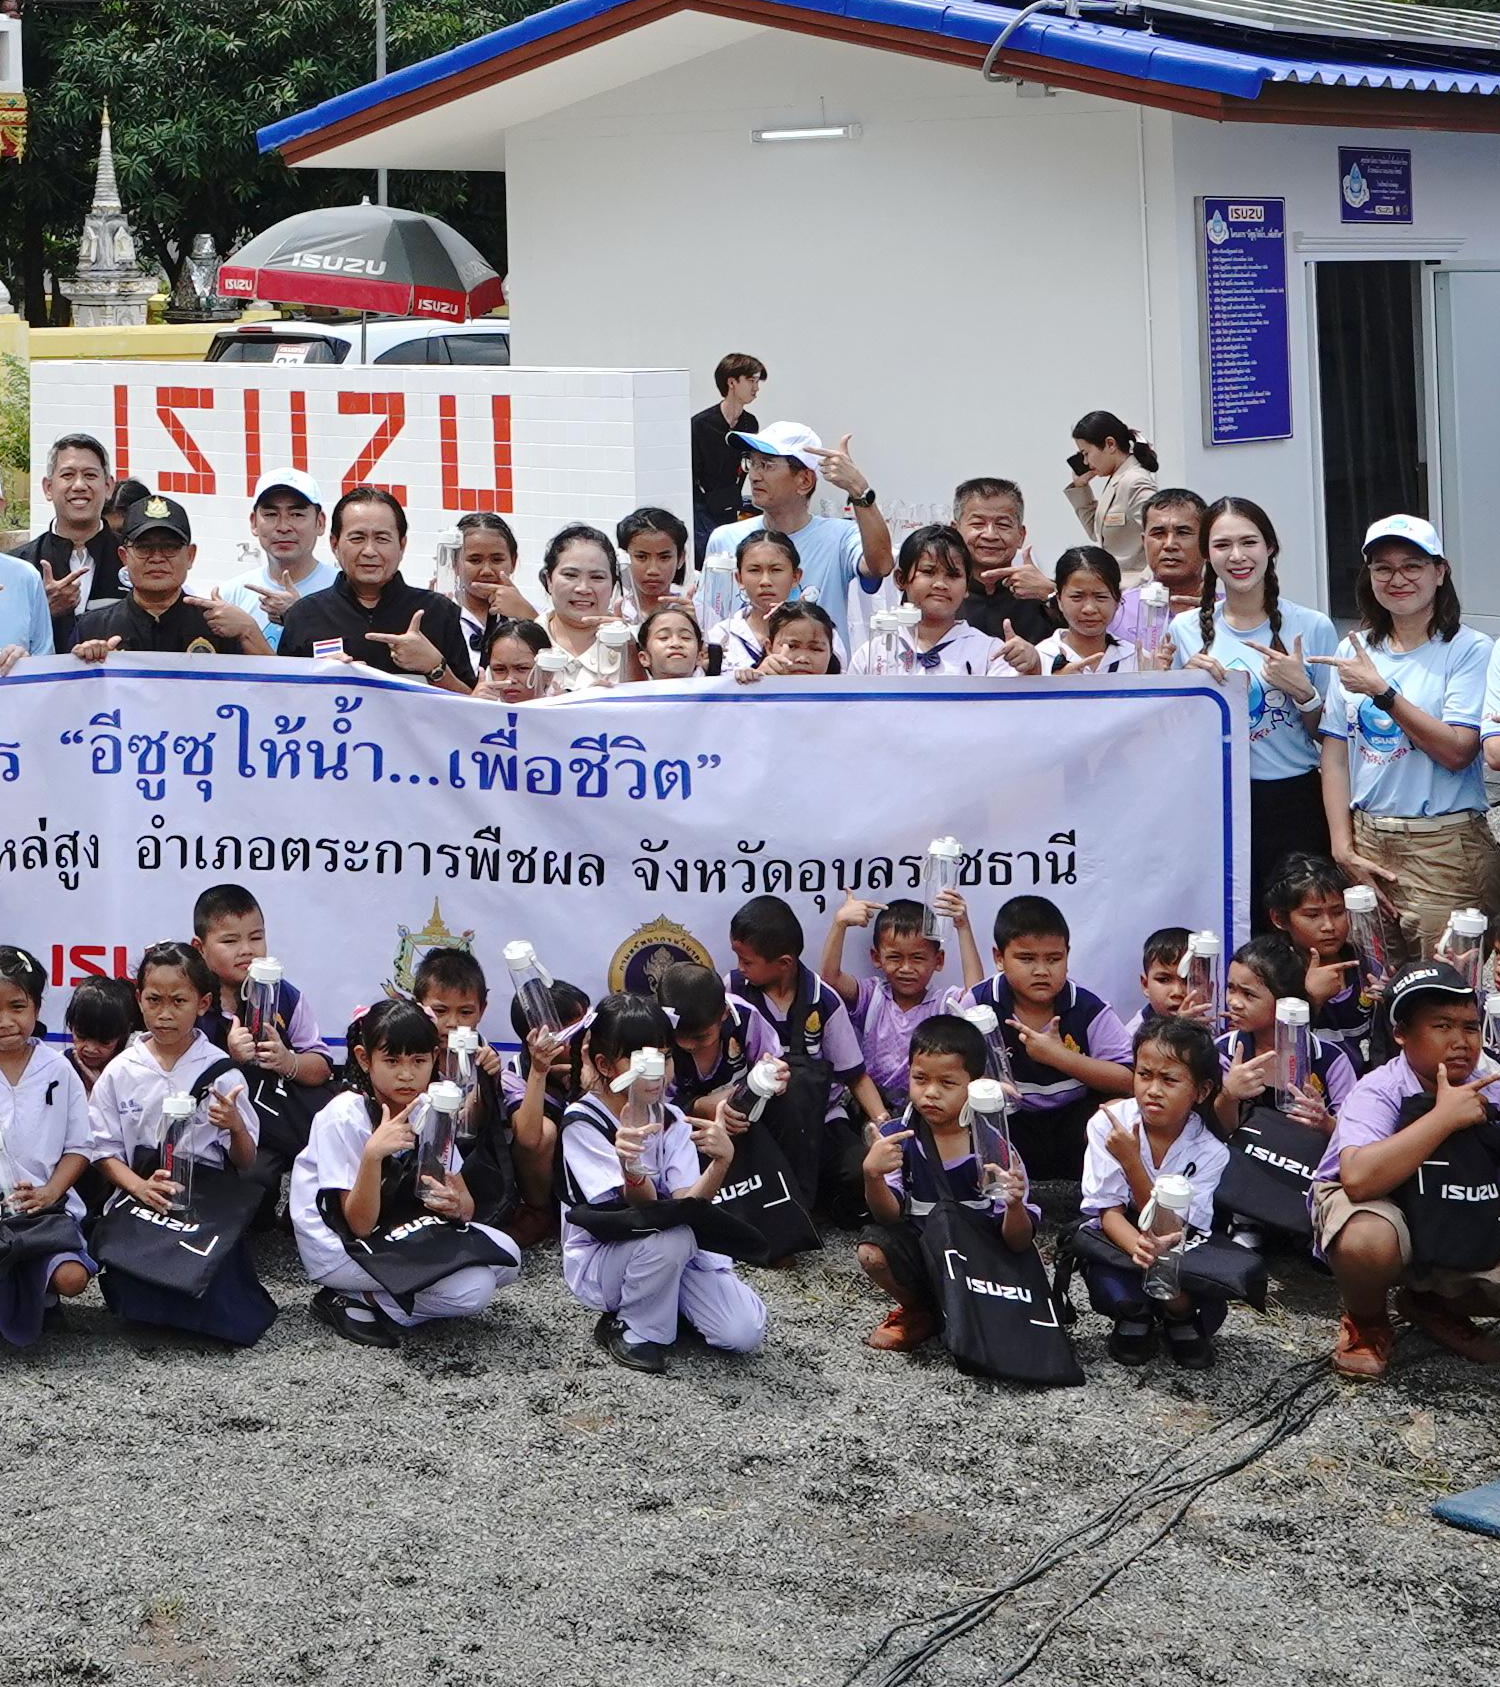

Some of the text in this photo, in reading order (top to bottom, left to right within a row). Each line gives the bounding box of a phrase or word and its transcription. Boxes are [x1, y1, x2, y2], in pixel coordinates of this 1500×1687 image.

[1230, 209, 1263, 220] ISUZU
[291, 252, 387, 276] ISUZU
[225, 278, 253, 291] ISUZU
[418, 299, 459, 316] ISUZU
[114, 385, 513, 513] ISUZU
[138, 815, 606, 887] อำเภอตระการพืชผล
[631, 829, 1078, 914] จังหวัดอุบลรชธานี
[1393, 967, 1439, 994] ISUZU
[1244, 1143, 1318, 1180] ISUZU
[711, 1174, 764, 1205] SUZU
[1441, 1183, 1500, 1202] ISUZU
[130, 1207, 201, 1233] ISUZU
[966, 1278, 1033, 1304] ISUZU
